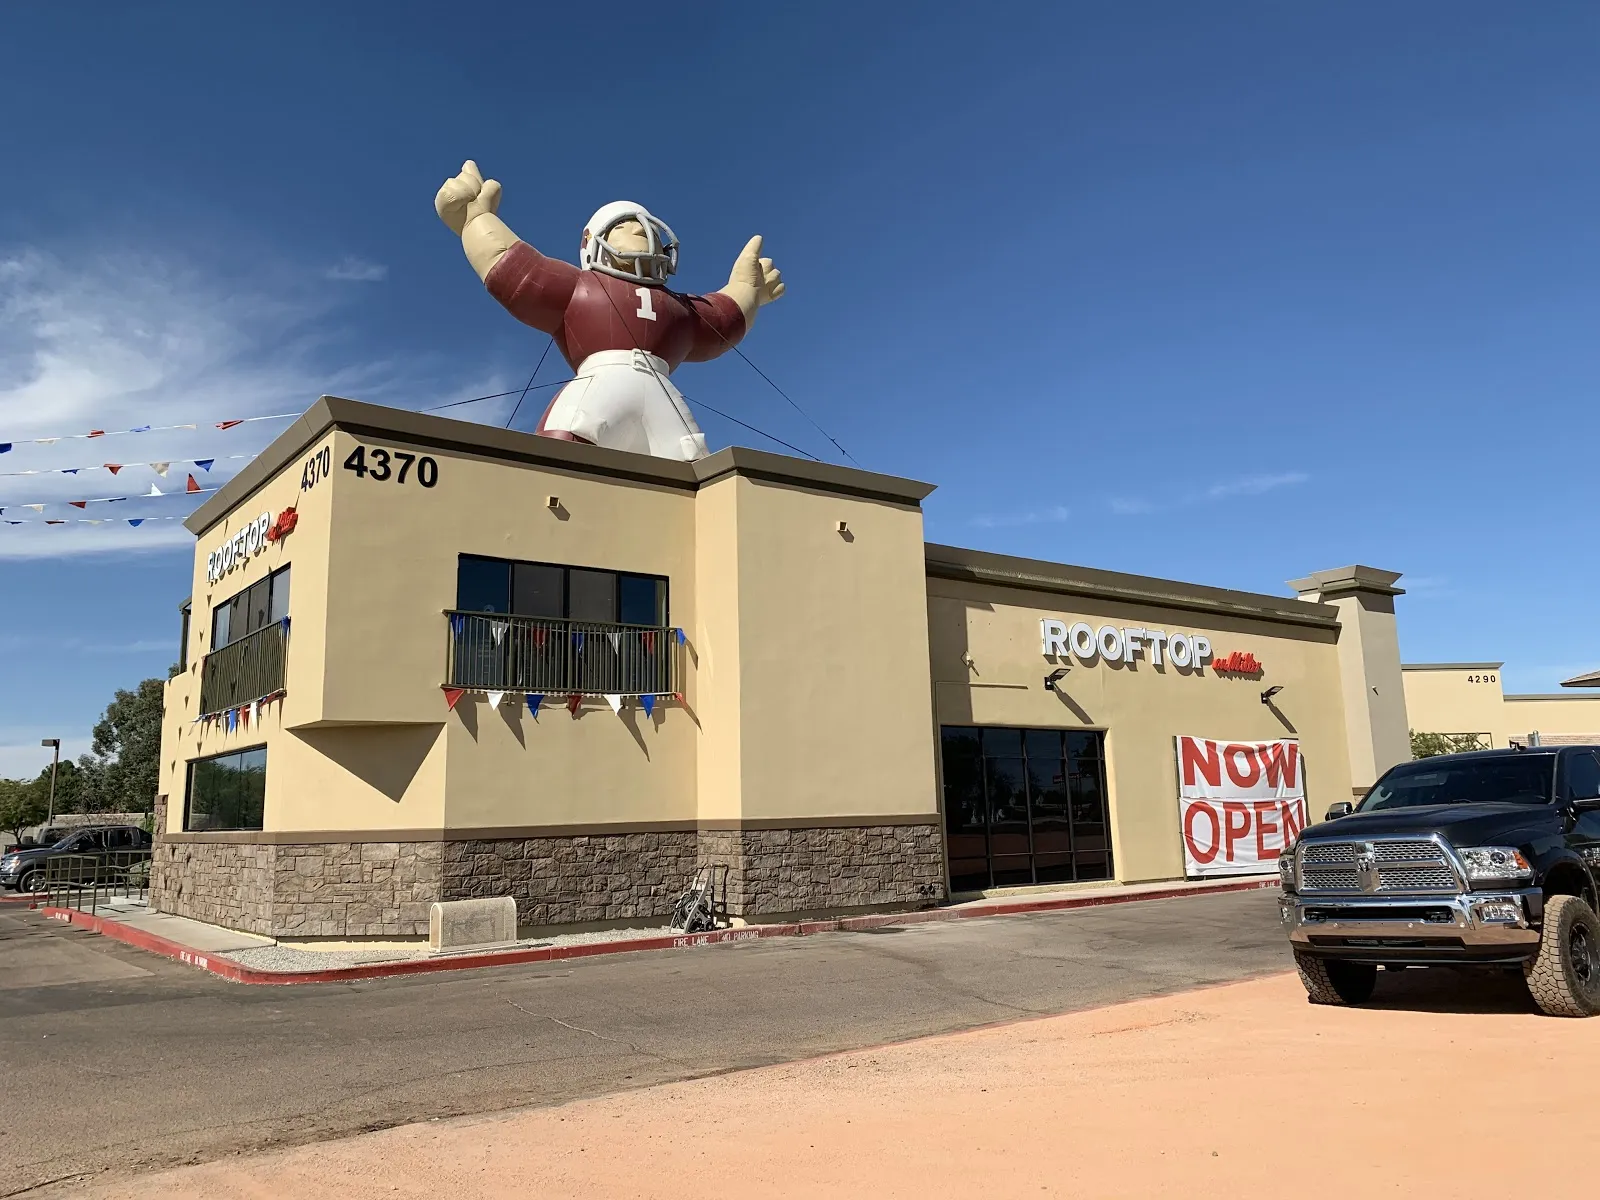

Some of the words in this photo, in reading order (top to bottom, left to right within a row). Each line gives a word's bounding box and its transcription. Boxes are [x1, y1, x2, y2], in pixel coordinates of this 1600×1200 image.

[635, 287, 657, 321] 1
[301, 446, 330, 492] 4370
[343, 445, 438, 488] 4370
[206, 511, 271, 583] ROOFTOP
[1040, 618, 1212, 669] ROOFTOP
[1467, 675, 1496, 683] 4290
[1180, 736, 1299, 788] NOW
[1184, 799, 1306, 865] OPEN
[673, 937, 689, 948] FIRE
[691, 935, 709, 946] LANE
[733, 930, 759, 941] PARKING
